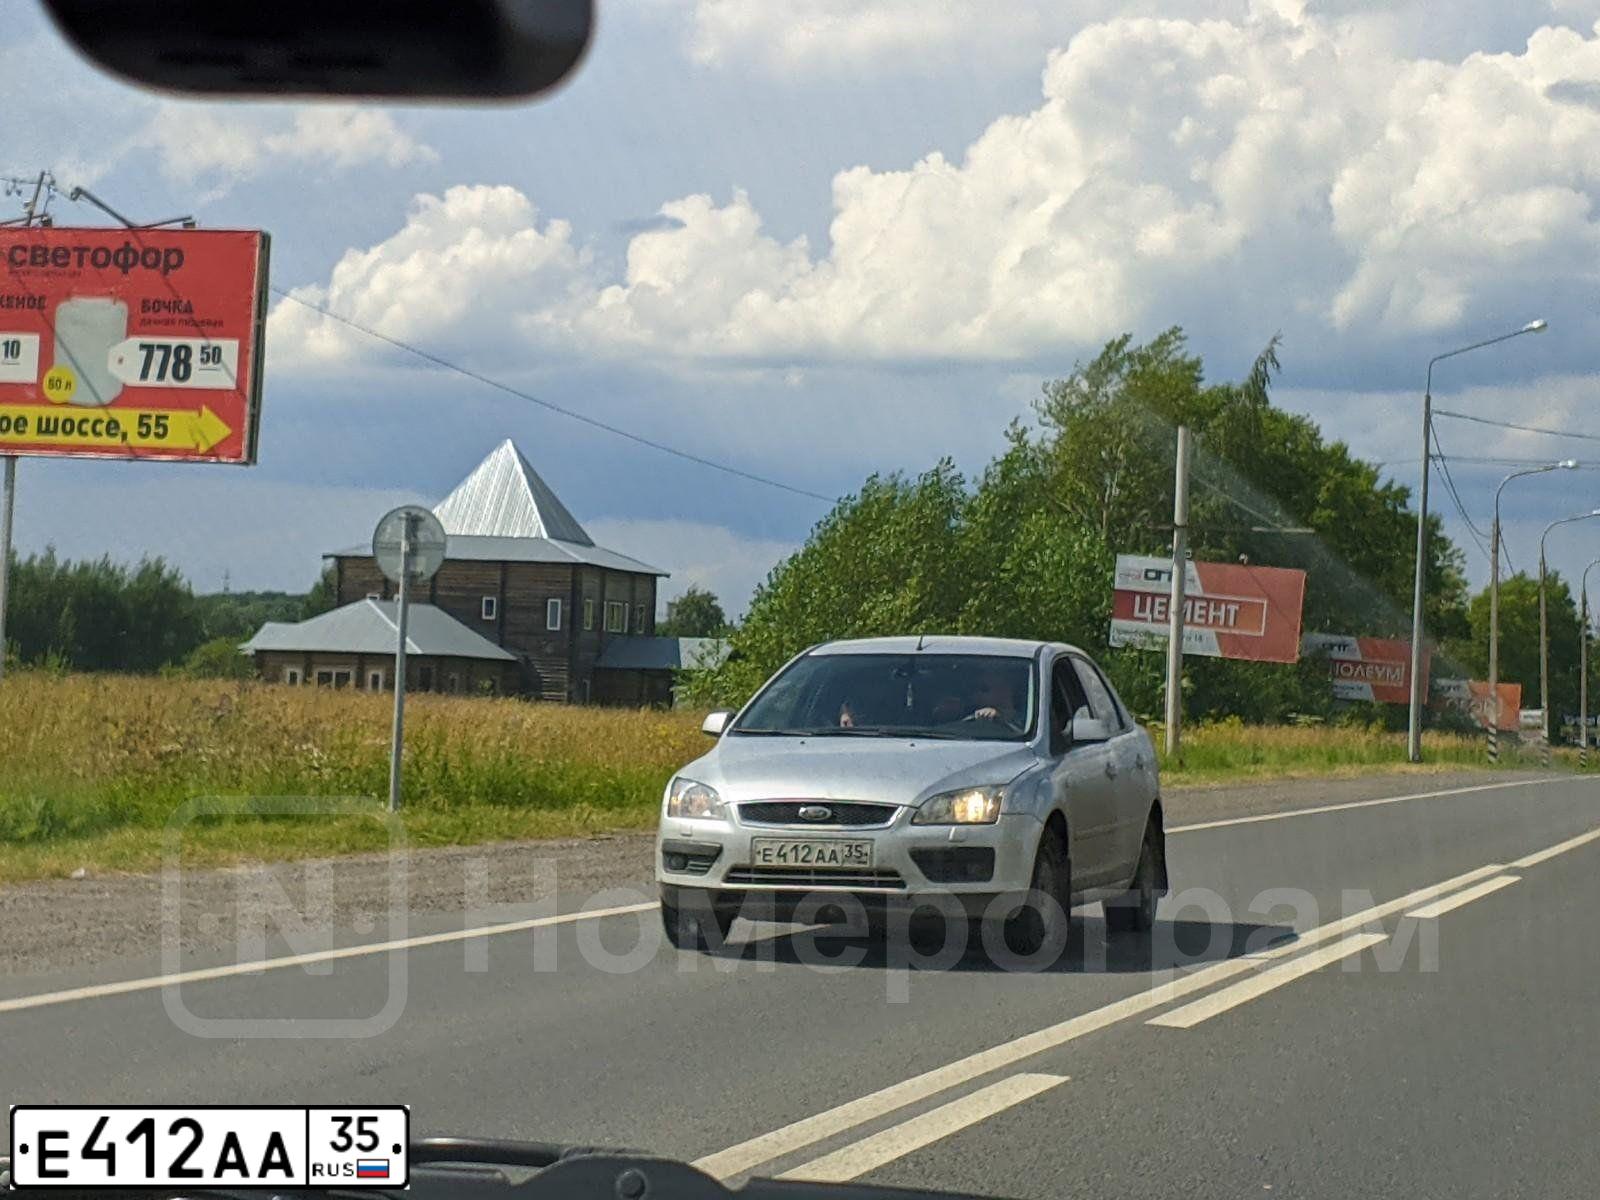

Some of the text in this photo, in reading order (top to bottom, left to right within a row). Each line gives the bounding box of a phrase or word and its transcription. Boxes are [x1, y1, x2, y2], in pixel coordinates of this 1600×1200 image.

[8, 241, 185, 276] светофор
[140, 299, 194, 315] БОЧКА
[2, 340, 20, 359] 10
[138, 344, 222, 382] 778 50
[36, 416, 128, 442] шоссе,
[137, 414, 170, 440] 55
